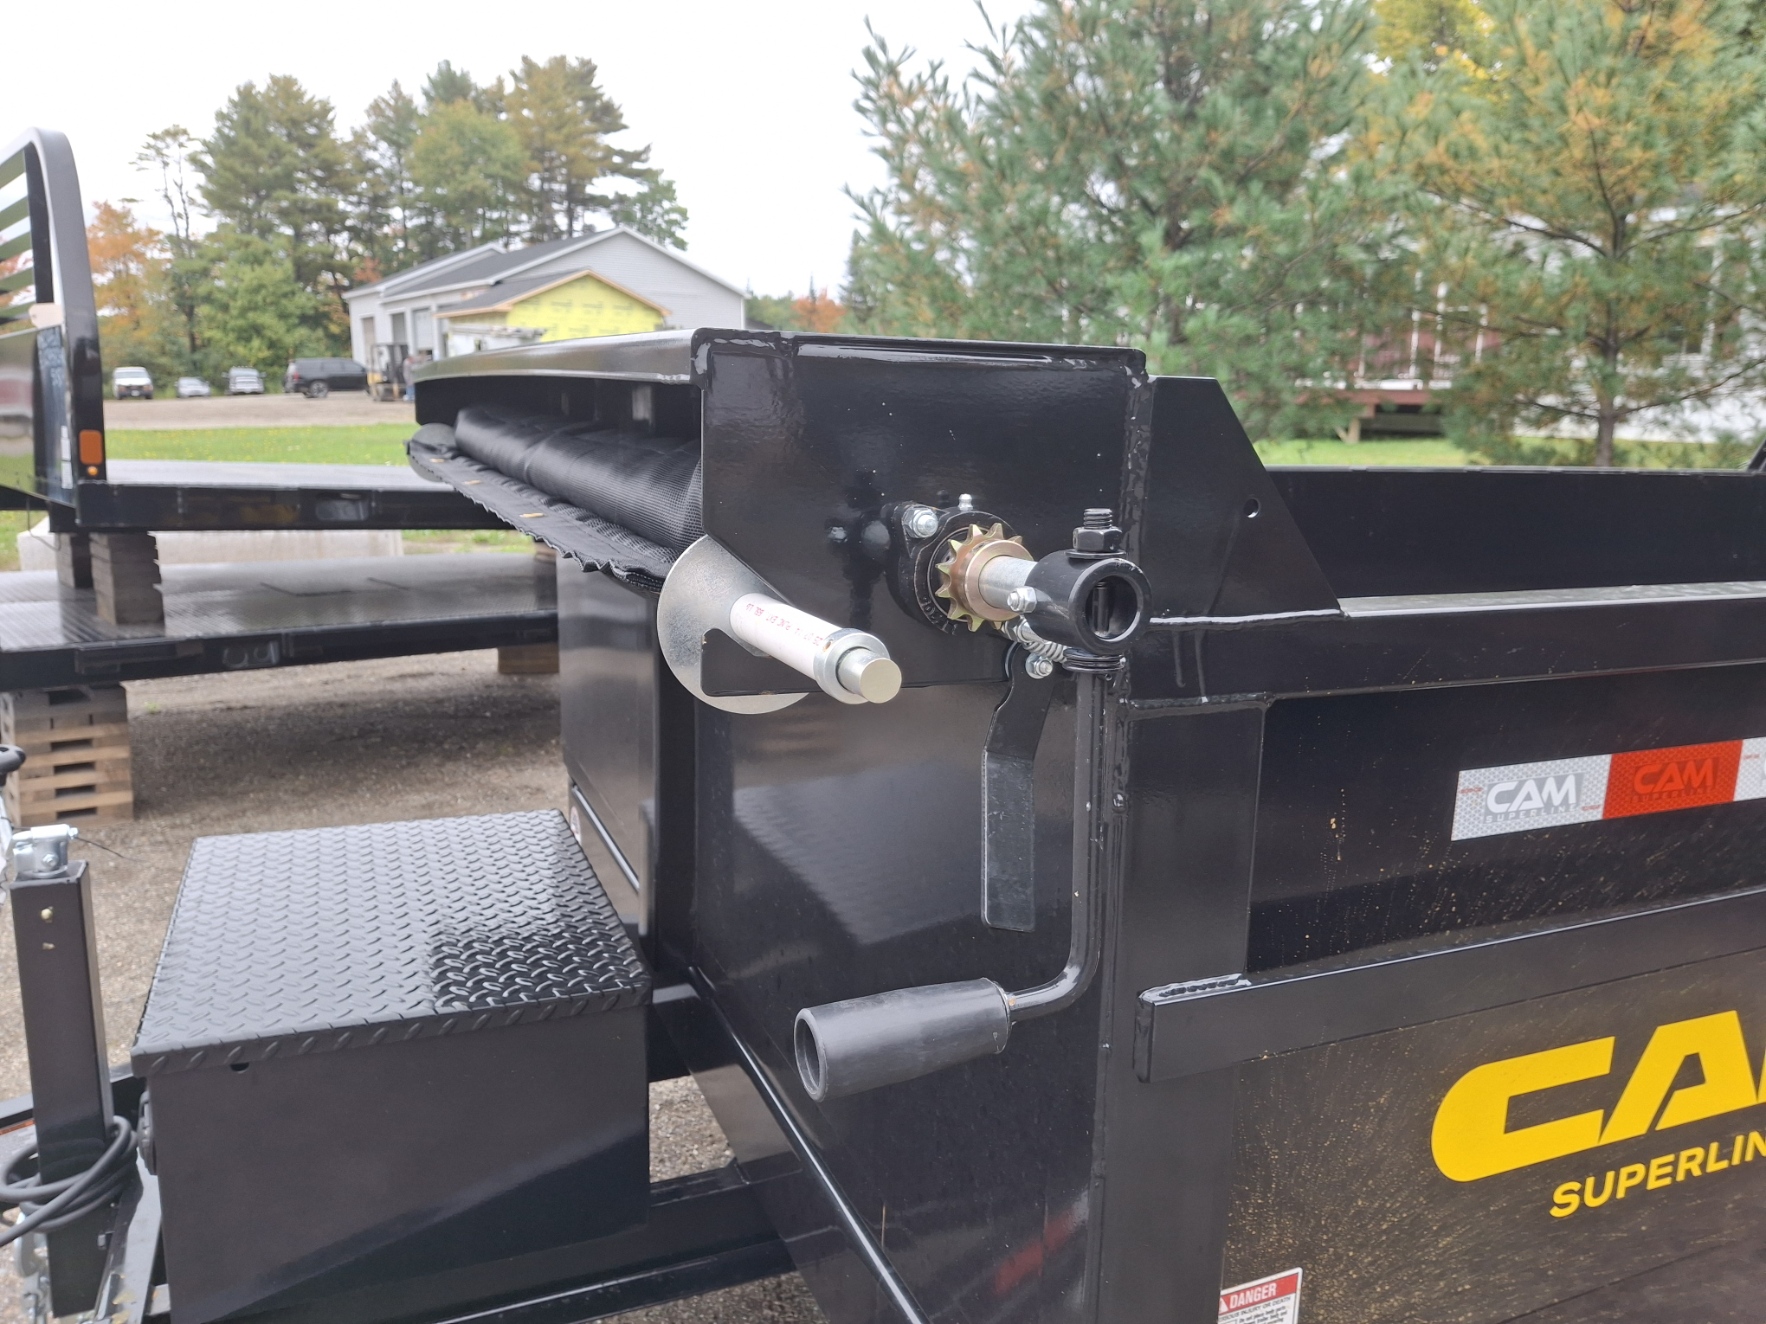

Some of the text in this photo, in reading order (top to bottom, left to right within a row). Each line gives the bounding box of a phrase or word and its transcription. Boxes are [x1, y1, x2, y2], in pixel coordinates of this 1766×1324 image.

[1487, 774, 1577, 813] CAM
[1633, 757, 1714, 795] CAM
[1485, 804, 1577, 824] SUPERLINE
[1431, 1010, 1766, 1182] CA
[1230, 1283, 1277, 1309] DANGER
